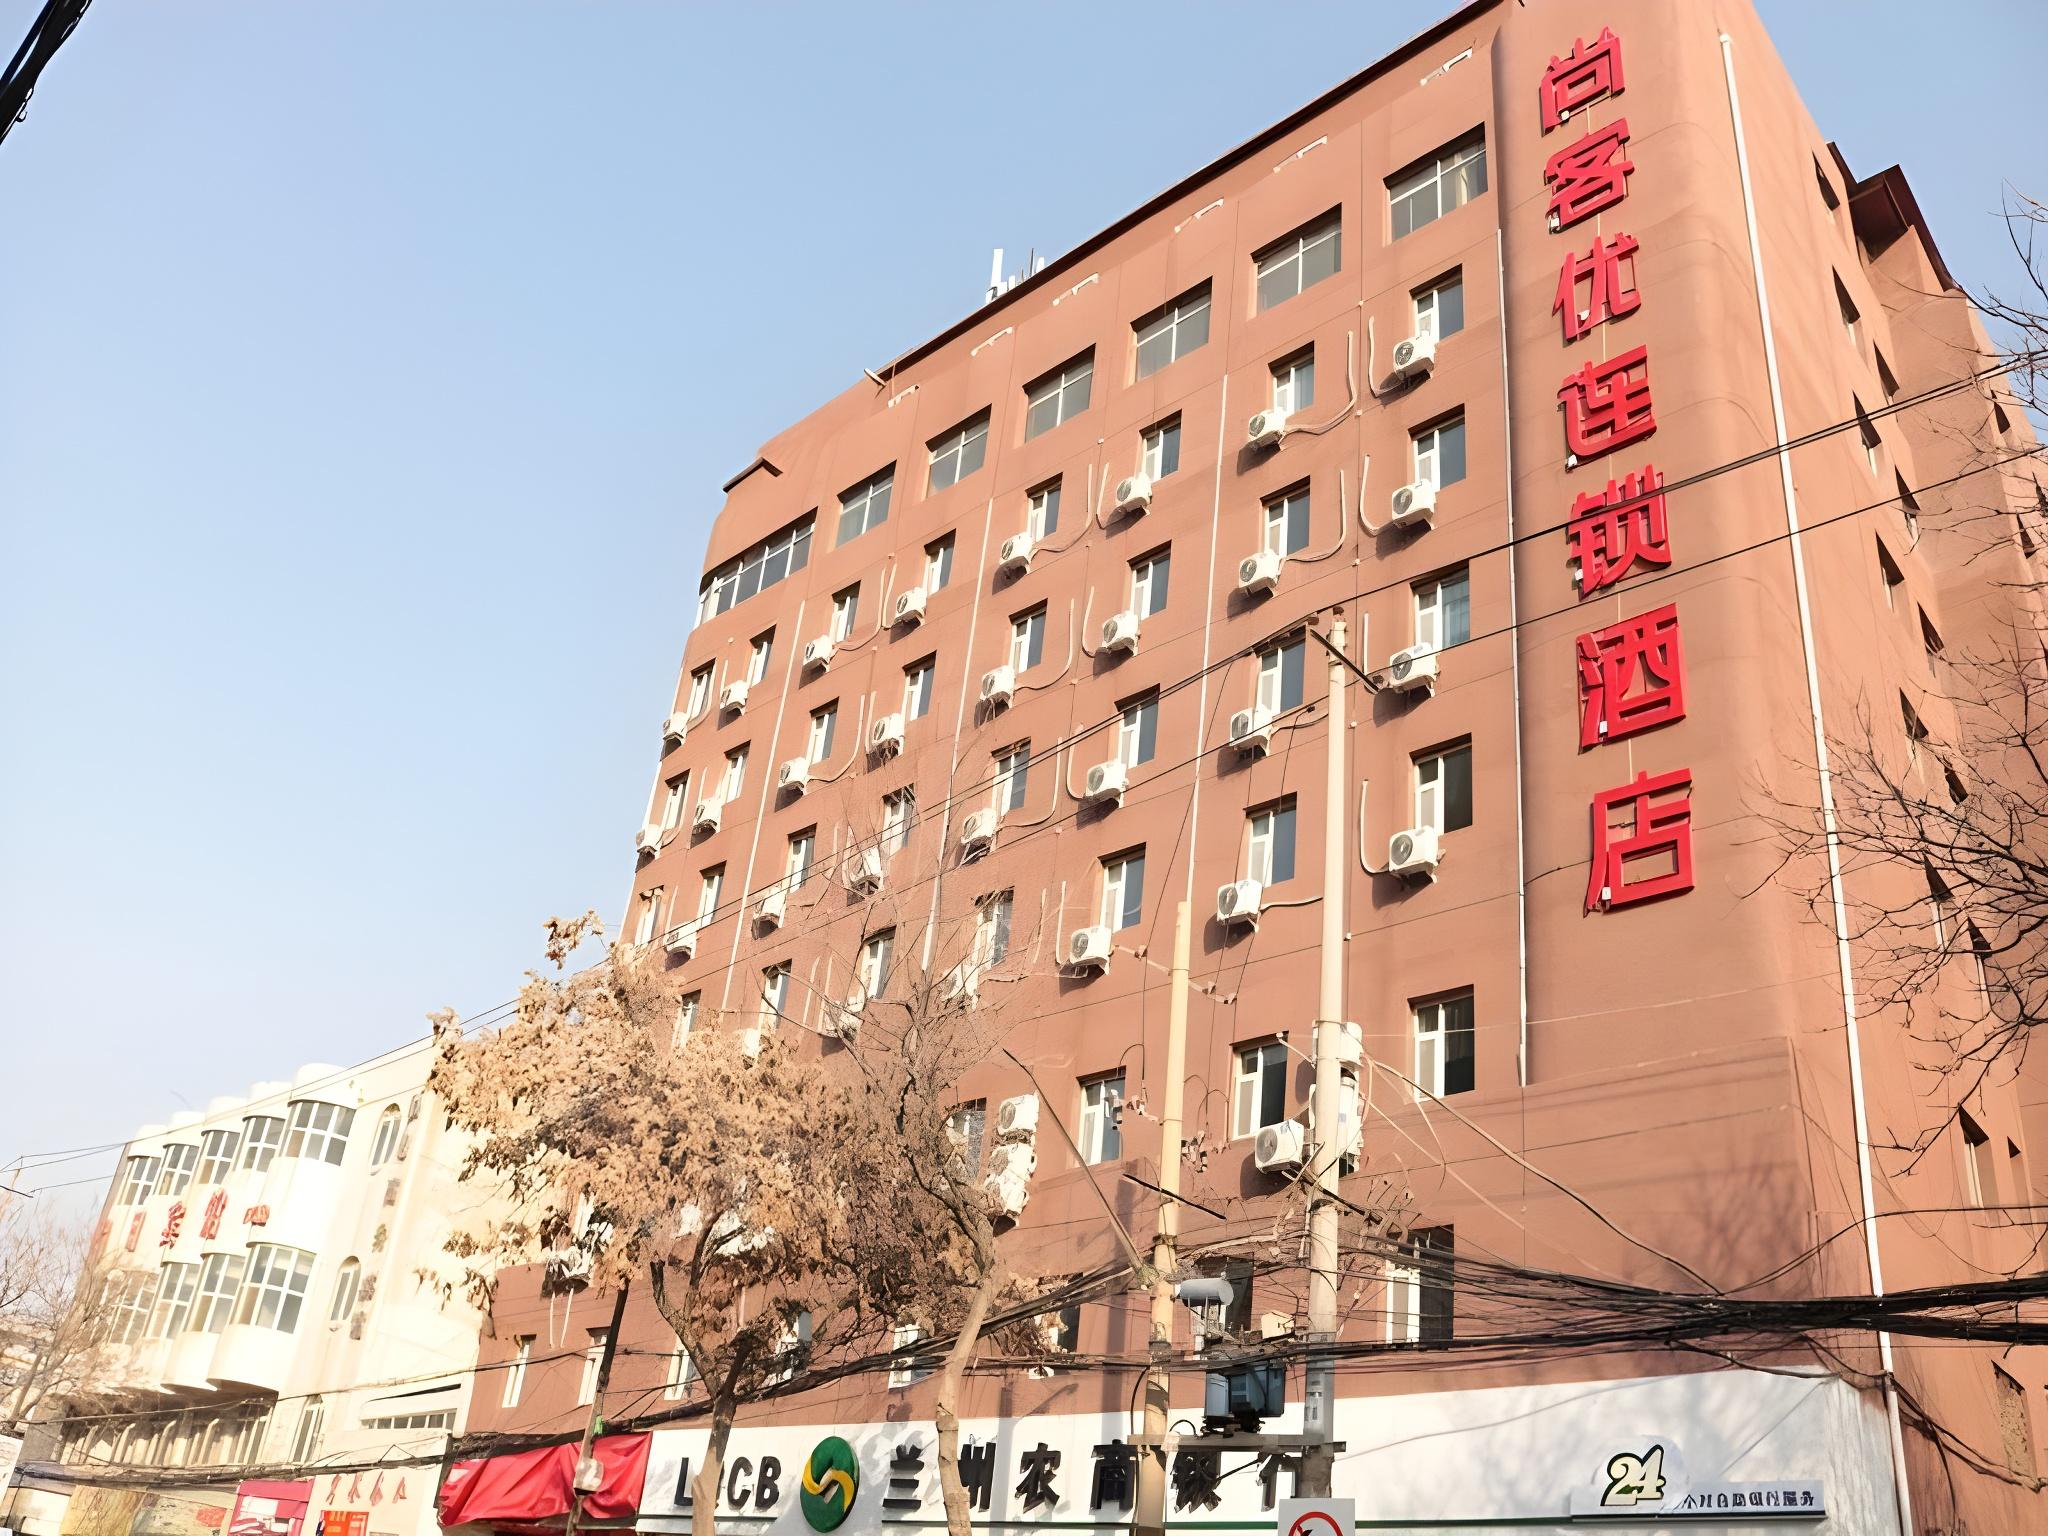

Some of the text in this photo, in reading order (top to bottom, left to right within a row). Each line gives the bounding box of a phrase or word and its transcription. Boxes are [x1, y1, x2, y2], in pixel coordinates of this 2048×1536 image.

[1540, 25, 1695, 917] 尚客优连锁酒店
[674, 1456, 781, 1509] LCB
[1600, 1444, 1666, 1506] 24
